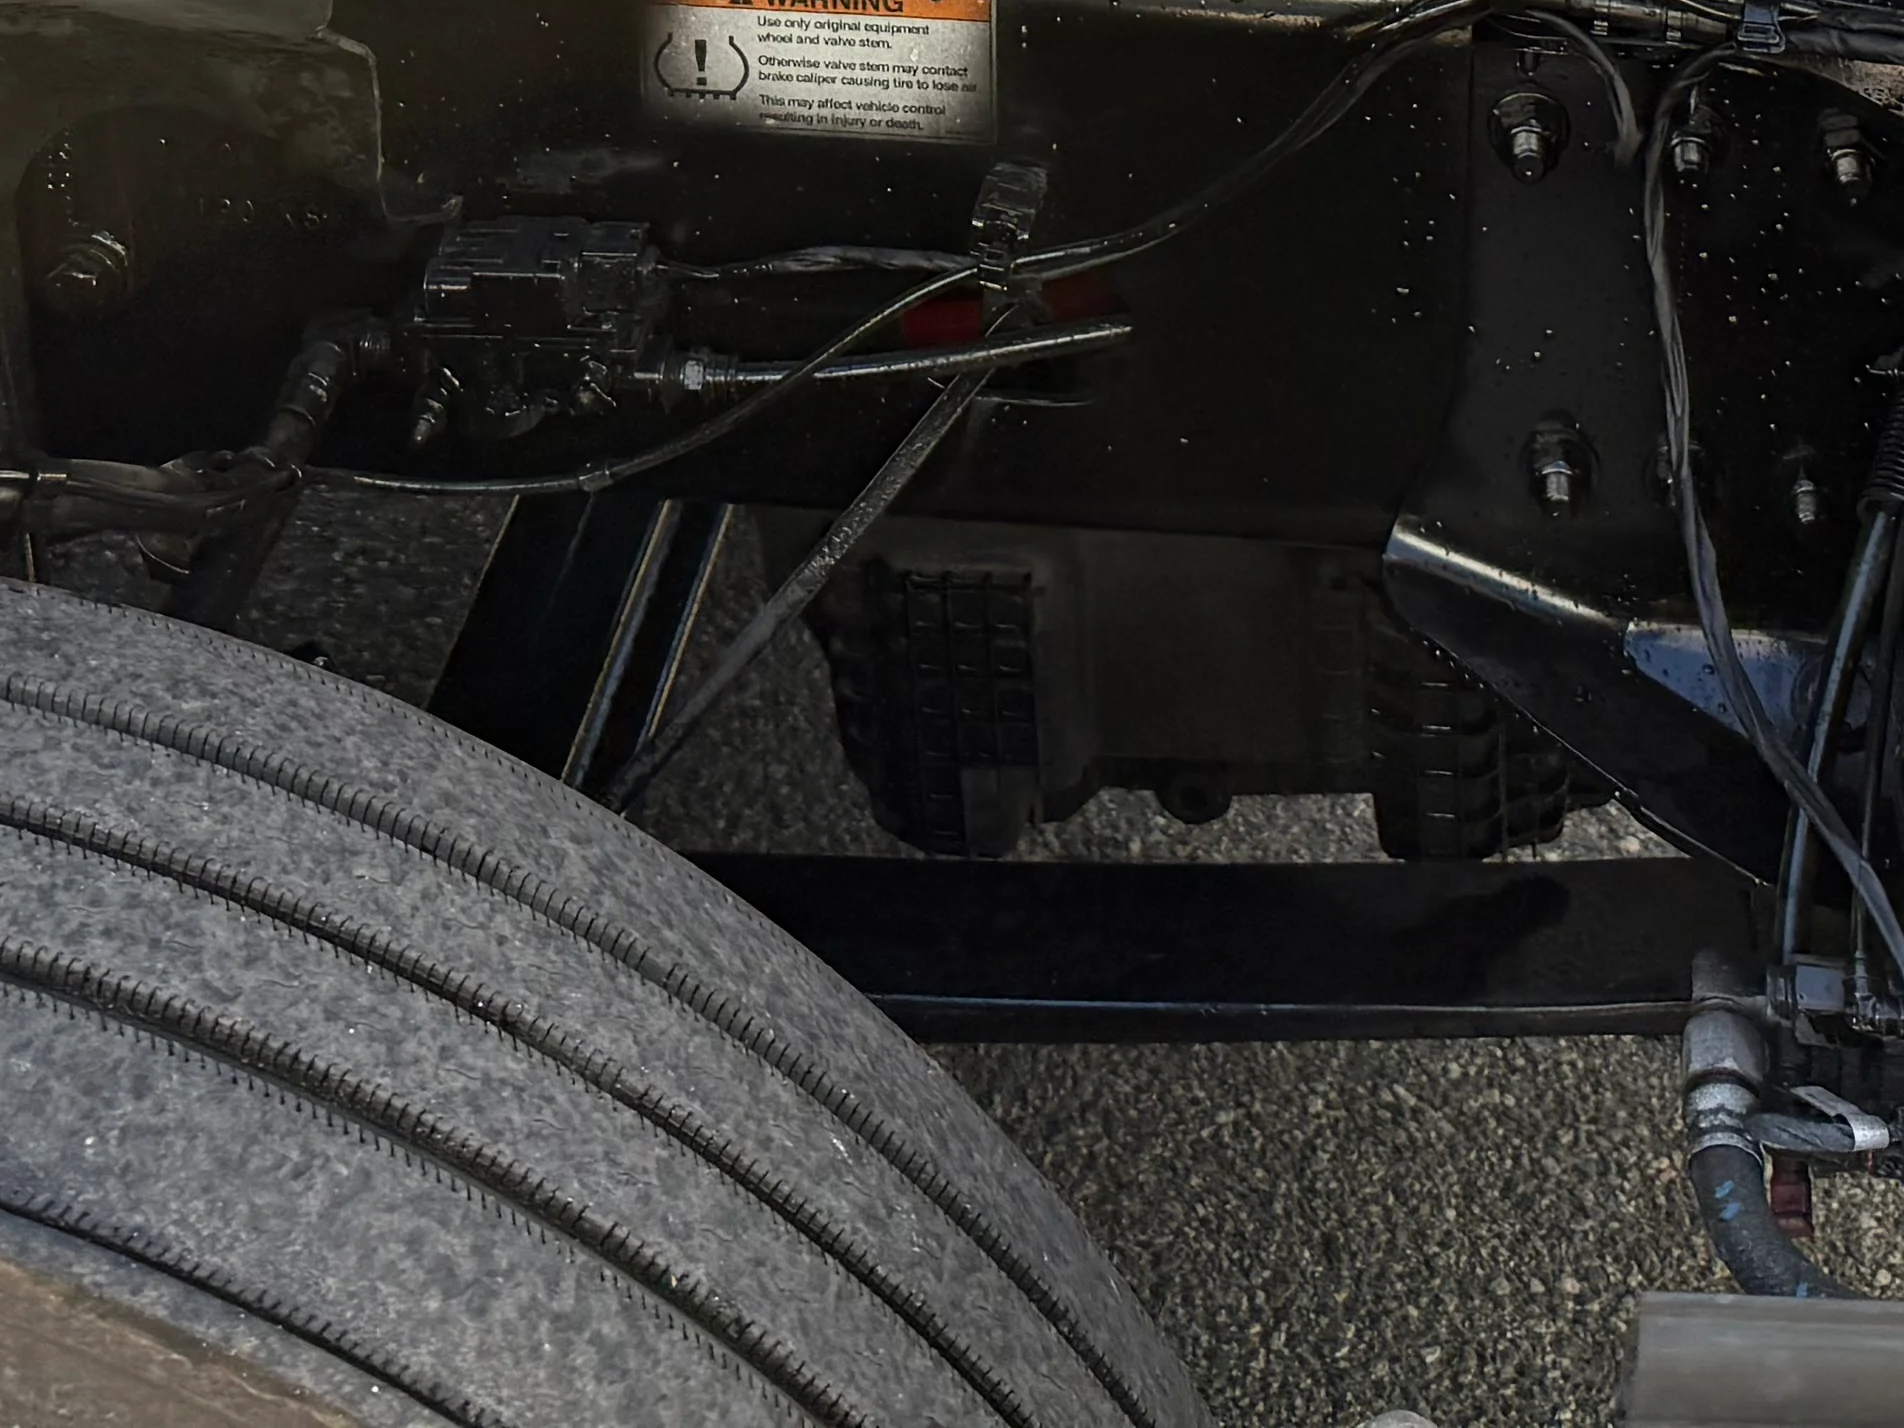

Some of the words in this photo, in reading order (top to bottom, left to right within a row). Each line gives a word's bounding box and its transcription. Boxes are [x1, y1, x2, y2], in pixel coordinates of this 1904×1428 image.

[757, 15, 782, 28] Use
[784, 16, 812, 32] only
[814, 19, 861, 33] original
[864, 21, 930, 37] equipment
[757, 33, 793, 44] wheel
[796, 34, 820, 45] and
[823, 35, 856, 47] valve
[859, 37, 893, 49] stem.
[758, 55, 820, 69] Otherwise
[823, 58, 856, 71] valve
[859, 61, 889, 73] stem
[892, 64, 919, 76] may
[922, 65, 969, 77] contact
[758, 70, 794, 83] brake
[796, 73, 837, 86] caliper
[841, 76, 889, 89] causing
[893, 79, 914, 89] tire
[917, 79, 929, 90] to
[932, 79, 959, 92] lose
[759, 94, 785, 106] This
[787, 97, 814, 110] may
[817, 96, 853, 110] affect
[856, 101, 899, 113] vehicle
[902, 102, 946, 116] control
[817, 112, 829, 124] in
[831, 113, 866, 128] injury
[869, 118, 882, 128] or
[885, 117, 924, 131] death.
